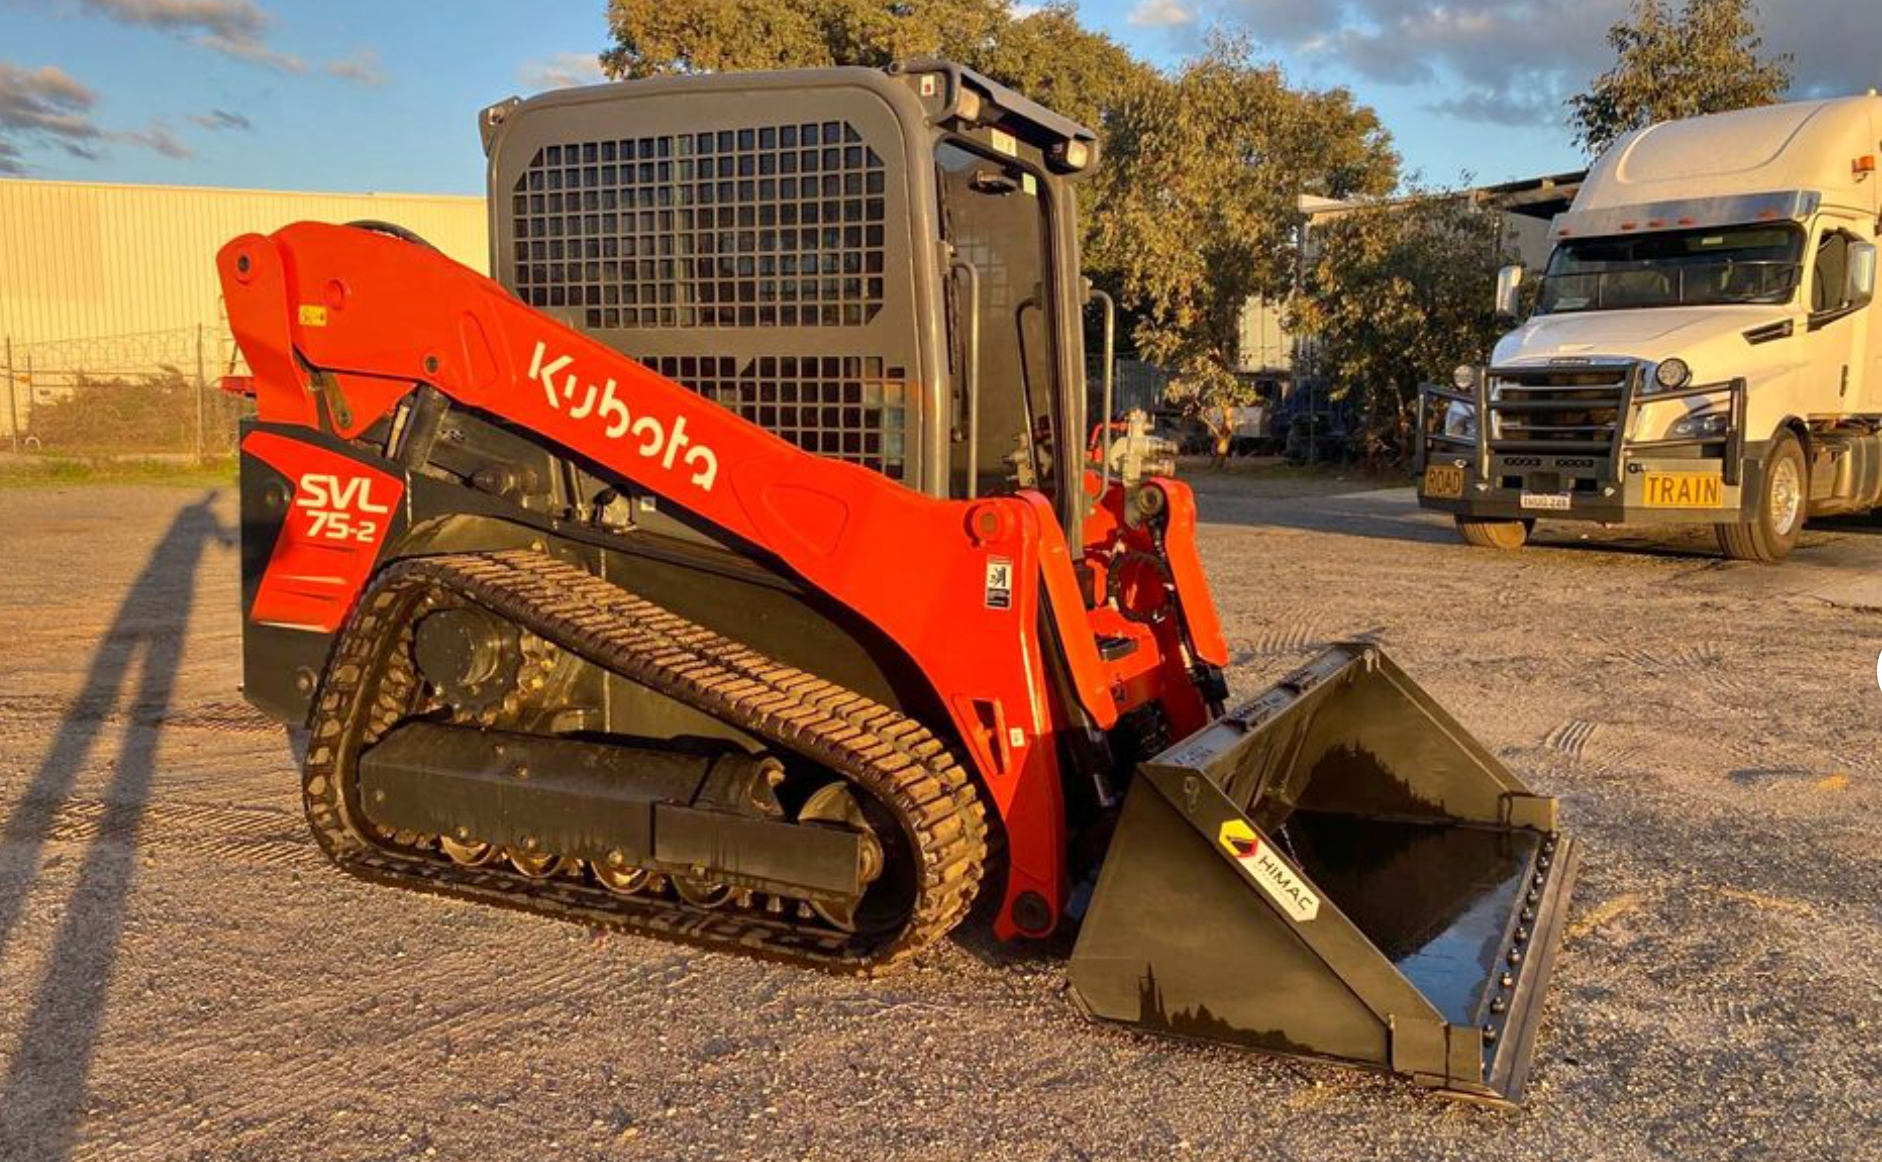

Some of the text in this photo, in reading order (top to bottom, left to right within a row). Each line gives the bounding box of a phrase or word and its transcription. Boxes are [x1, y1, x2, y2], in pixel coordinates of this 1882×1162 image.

[528, 341, 718, 492] Kubota
[296, 472, 389, 514] SVL
[1428, 470, 1461, 495] ROAD
[1647, 476, 1718, 504] TRAIN
[306, 509, 376, 543] 75-2
[1258, 855, 1313, 911] HIMAC
